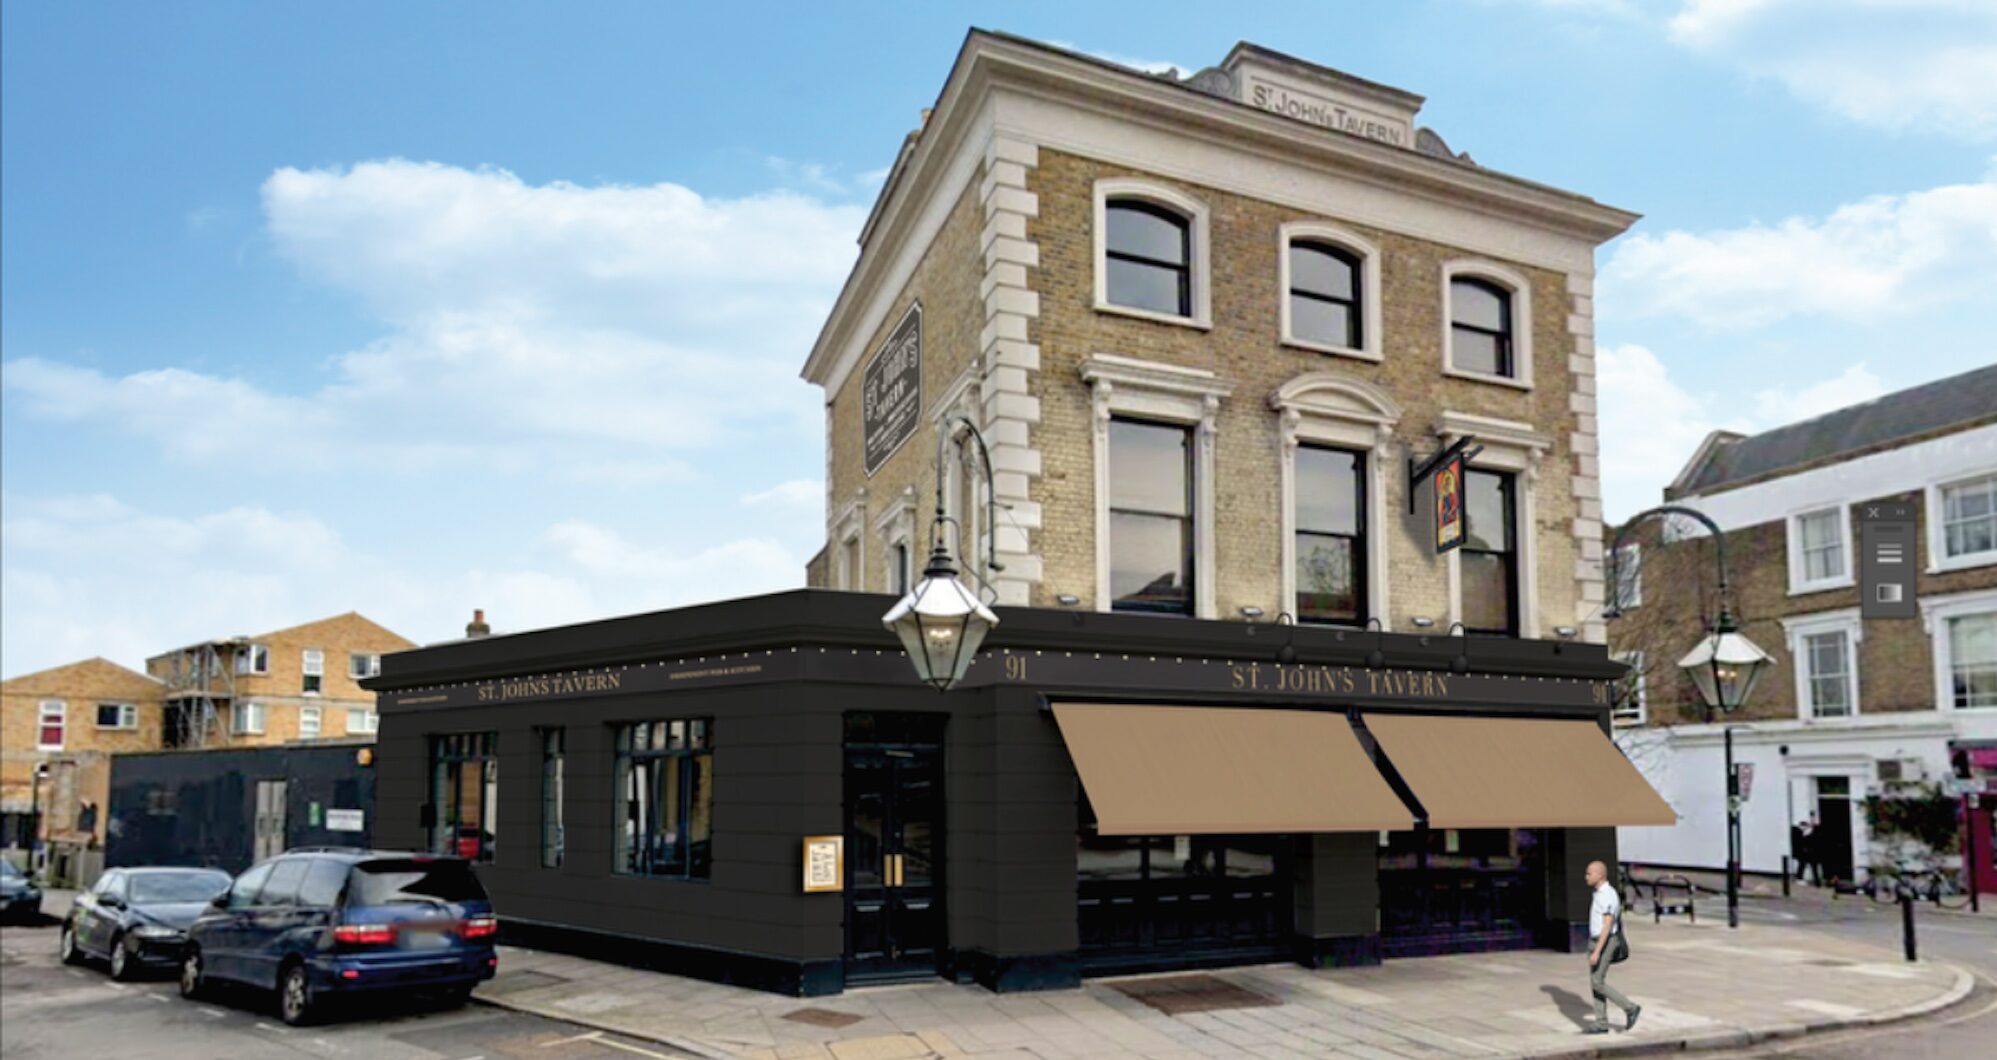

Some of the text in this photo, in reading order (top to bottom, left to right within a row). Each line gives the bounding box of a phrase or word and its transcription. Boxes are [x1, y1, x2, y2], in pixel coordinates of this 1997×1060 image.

[1334, 106, 1401, 144] TAVERN
[1005, 655, 1026, 680] 91
[1231, 665, 1448, 697] ST. JOHN'S TAVERN
[478, 684, 500, 701] ST.
[551, 672, 621, 694] TAVERN
